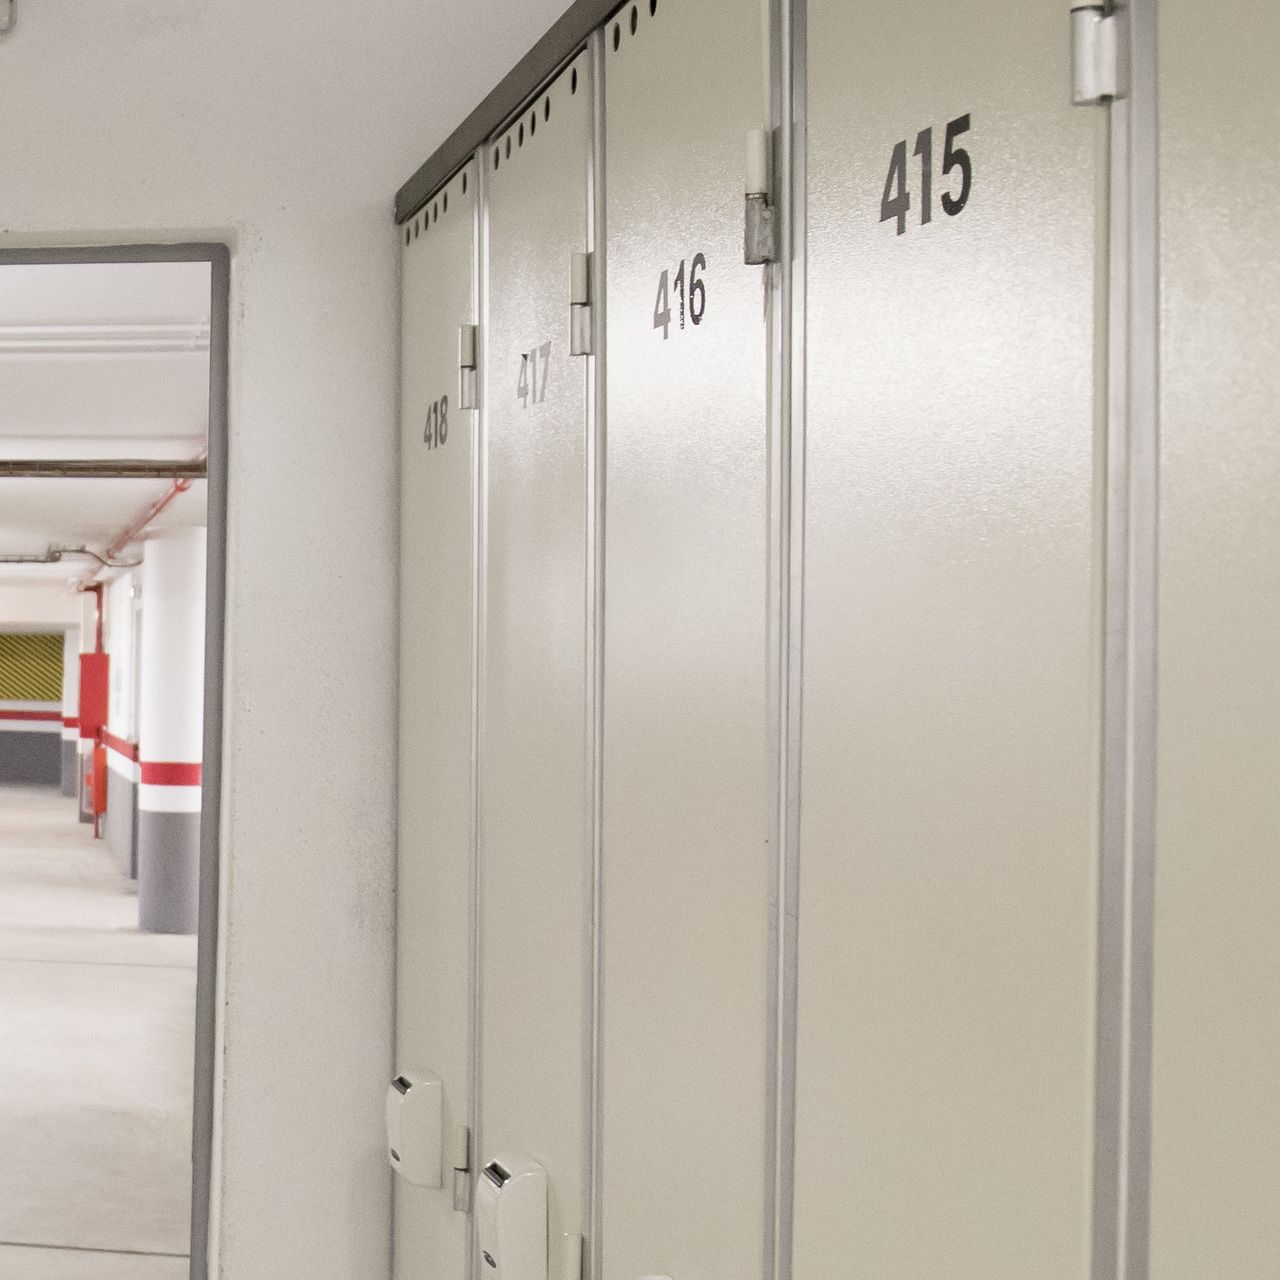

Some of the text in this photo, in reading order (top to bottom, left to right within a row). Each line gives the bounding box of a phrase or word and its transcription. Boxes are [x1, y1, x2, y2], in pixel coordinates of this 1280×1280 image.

[879, 113, 972, 236] 415
[653, 252, 707, 340] 416
[517, 341, 551, 408] 417
[423, 394, 449, 450] 418
